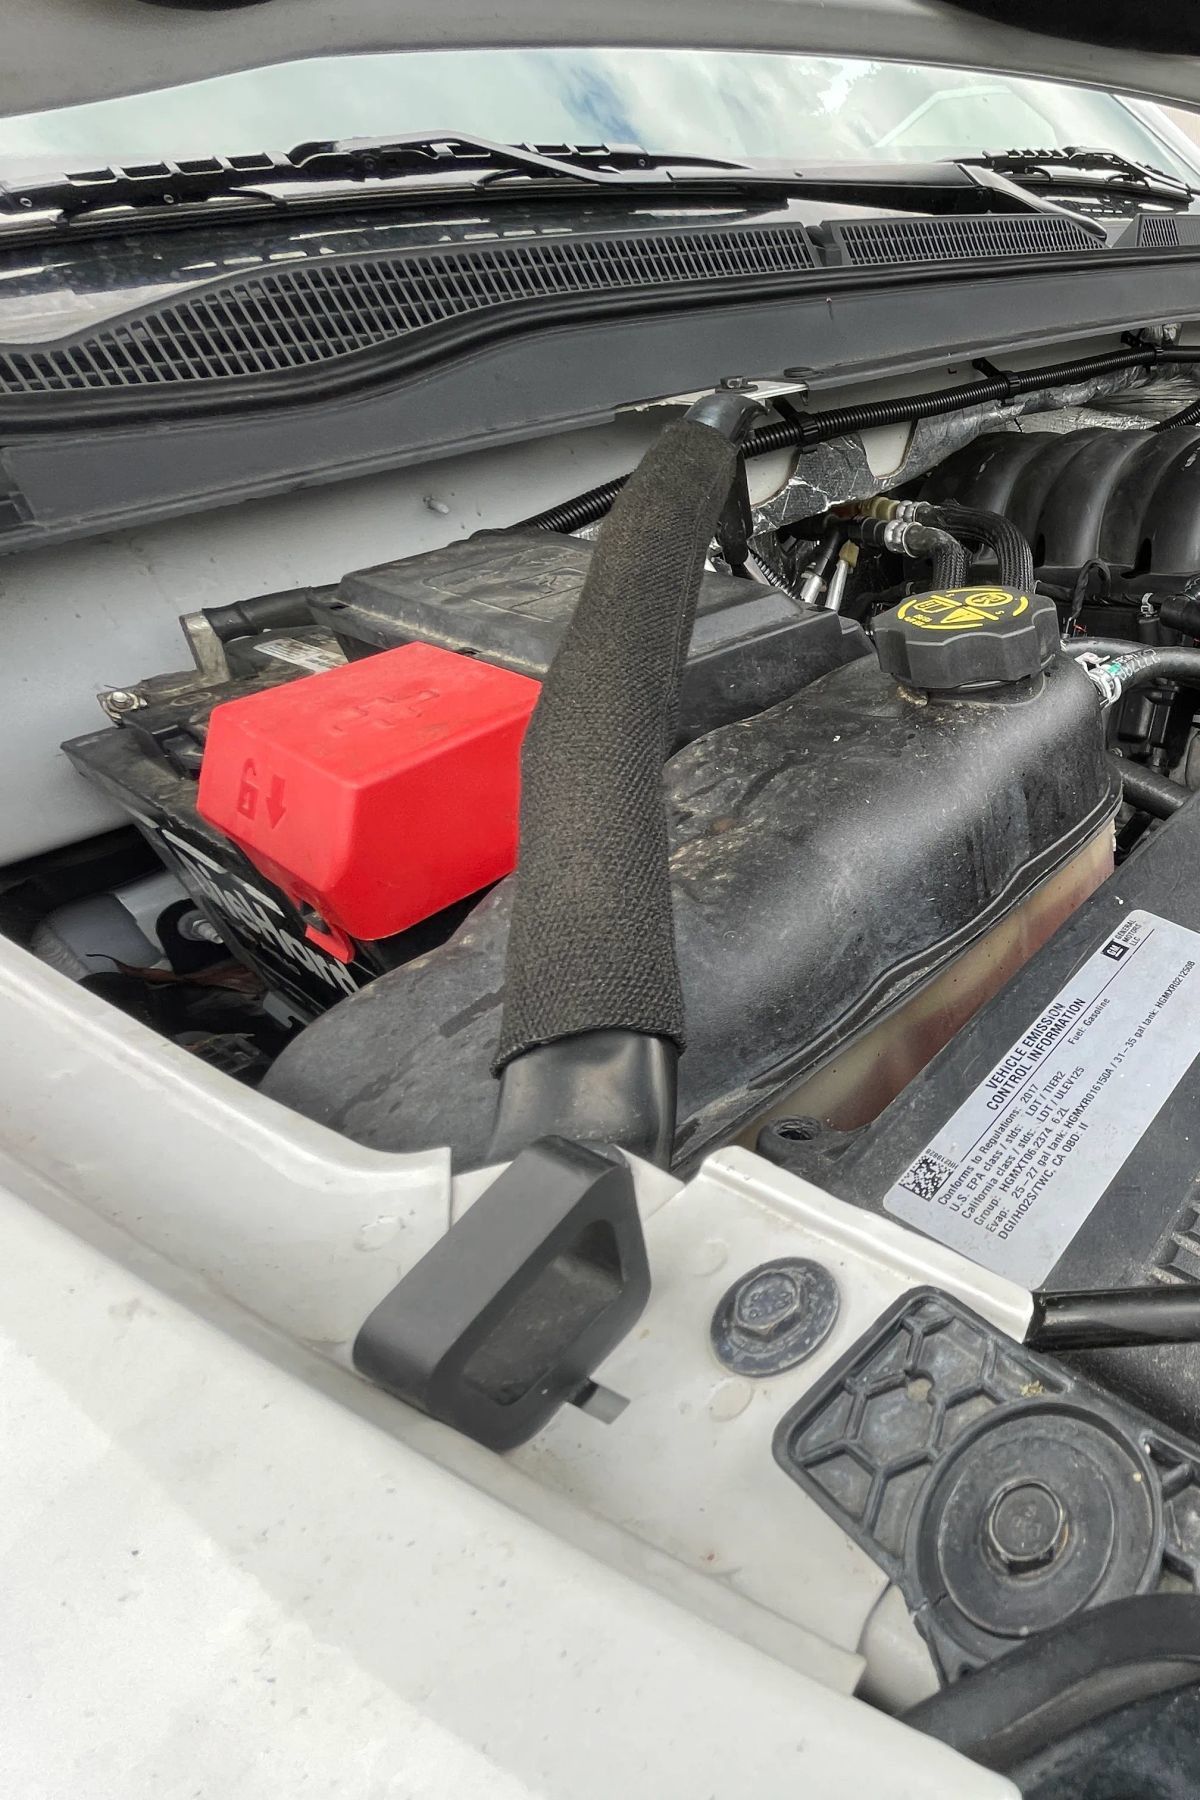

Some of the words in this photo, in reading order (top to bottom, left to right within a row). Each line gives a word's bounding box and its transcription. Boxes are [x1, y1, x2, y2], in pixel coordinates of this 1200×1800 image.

[1114, 920, 1136, 939] GENERAL
[1122, 923, 1142, 943] MOTORS
[1129, 936, 1141, 946] LLC
[985, 1047, 1027, 1089] VEHICLE
[1022, 1003, 1065, 1048] EMISSION
[986, 1064, 1032, 1110] CONTROL
[1027, 998, 1086, 1062] INFORMATION
[1067, 1027, 1086, 1045] Fuel:
[1083, 998, 1110, 1026] Gasoline
[937, 1165, 974, 1205] Conforms
[971, 1155, 982, 1164] to
[978, 1107, 1022, 1154] Regulations:
[1020, 1083, 1038, 1104] 2017
[949, 1194, 970, 1212] U.S.
[966, 1173, 986, 1191] EPA
[983, 1150, 1003, 1172] class
[1005, 1124, 1023, 1144] stds:
[1025, 1099, 1042, 1117] LDT
[1042, 1071, 1066, 1093] TIER2
[961, 1177, 998, 1219] California
[996, 1155, 1016, 1177] class
[1018, 1129, 1036, 1149] stds:
[1036, 1104, 1053, 1122] LDT
[1054, 1066, 1085, 1100] ULEV125
[973, 1196, 1001, 1226] Group:
[998, 1127, 1053, 1193] HGMXT06.2374
[1051, 1107, 1070, 1124] 6.2L
[985, 1207, 1010, 1233] Evap:
[1037, 1151, 1051, 1167] gal
[1047, 1130, 1068, 1151] tank:
[1134, 1025, 1146, 1038] gal
[1142, 1009, 1159, 1026] tank:
[1052, 1154, 1066, 1166] CA
[1062, 1132, 1082, 1152] OBD:
[1078, 1122, 1088, 1130] II
